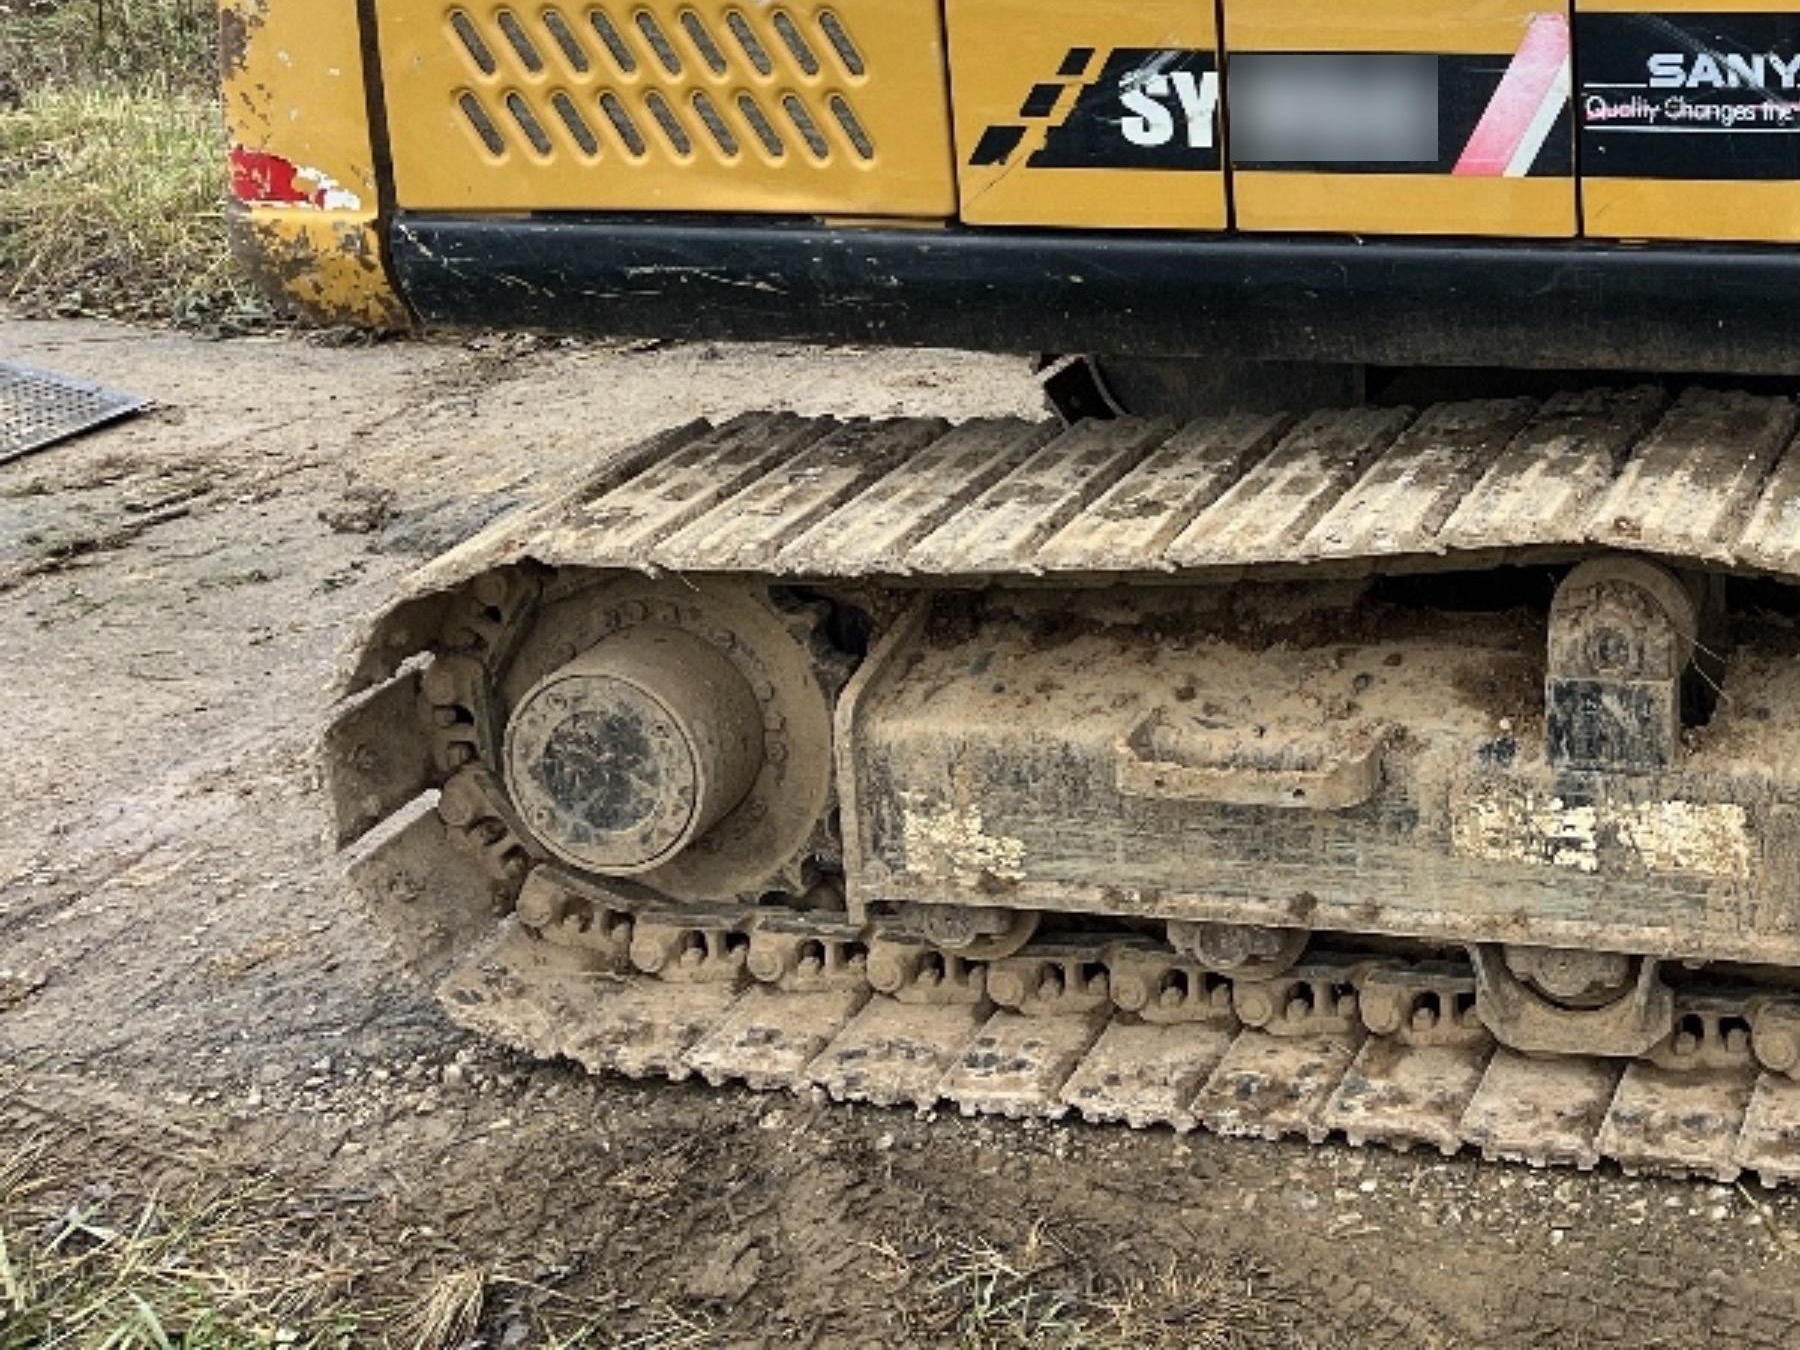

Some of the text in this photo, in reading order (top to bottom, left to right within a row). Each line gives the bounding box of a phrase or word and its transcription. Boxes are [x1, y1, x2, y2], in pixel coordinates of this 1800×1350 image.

[1585, 96, 1660, 123] Quality
[1664, 96, 1755, 126] Changes
[1761, 102, 1794, 122] the
